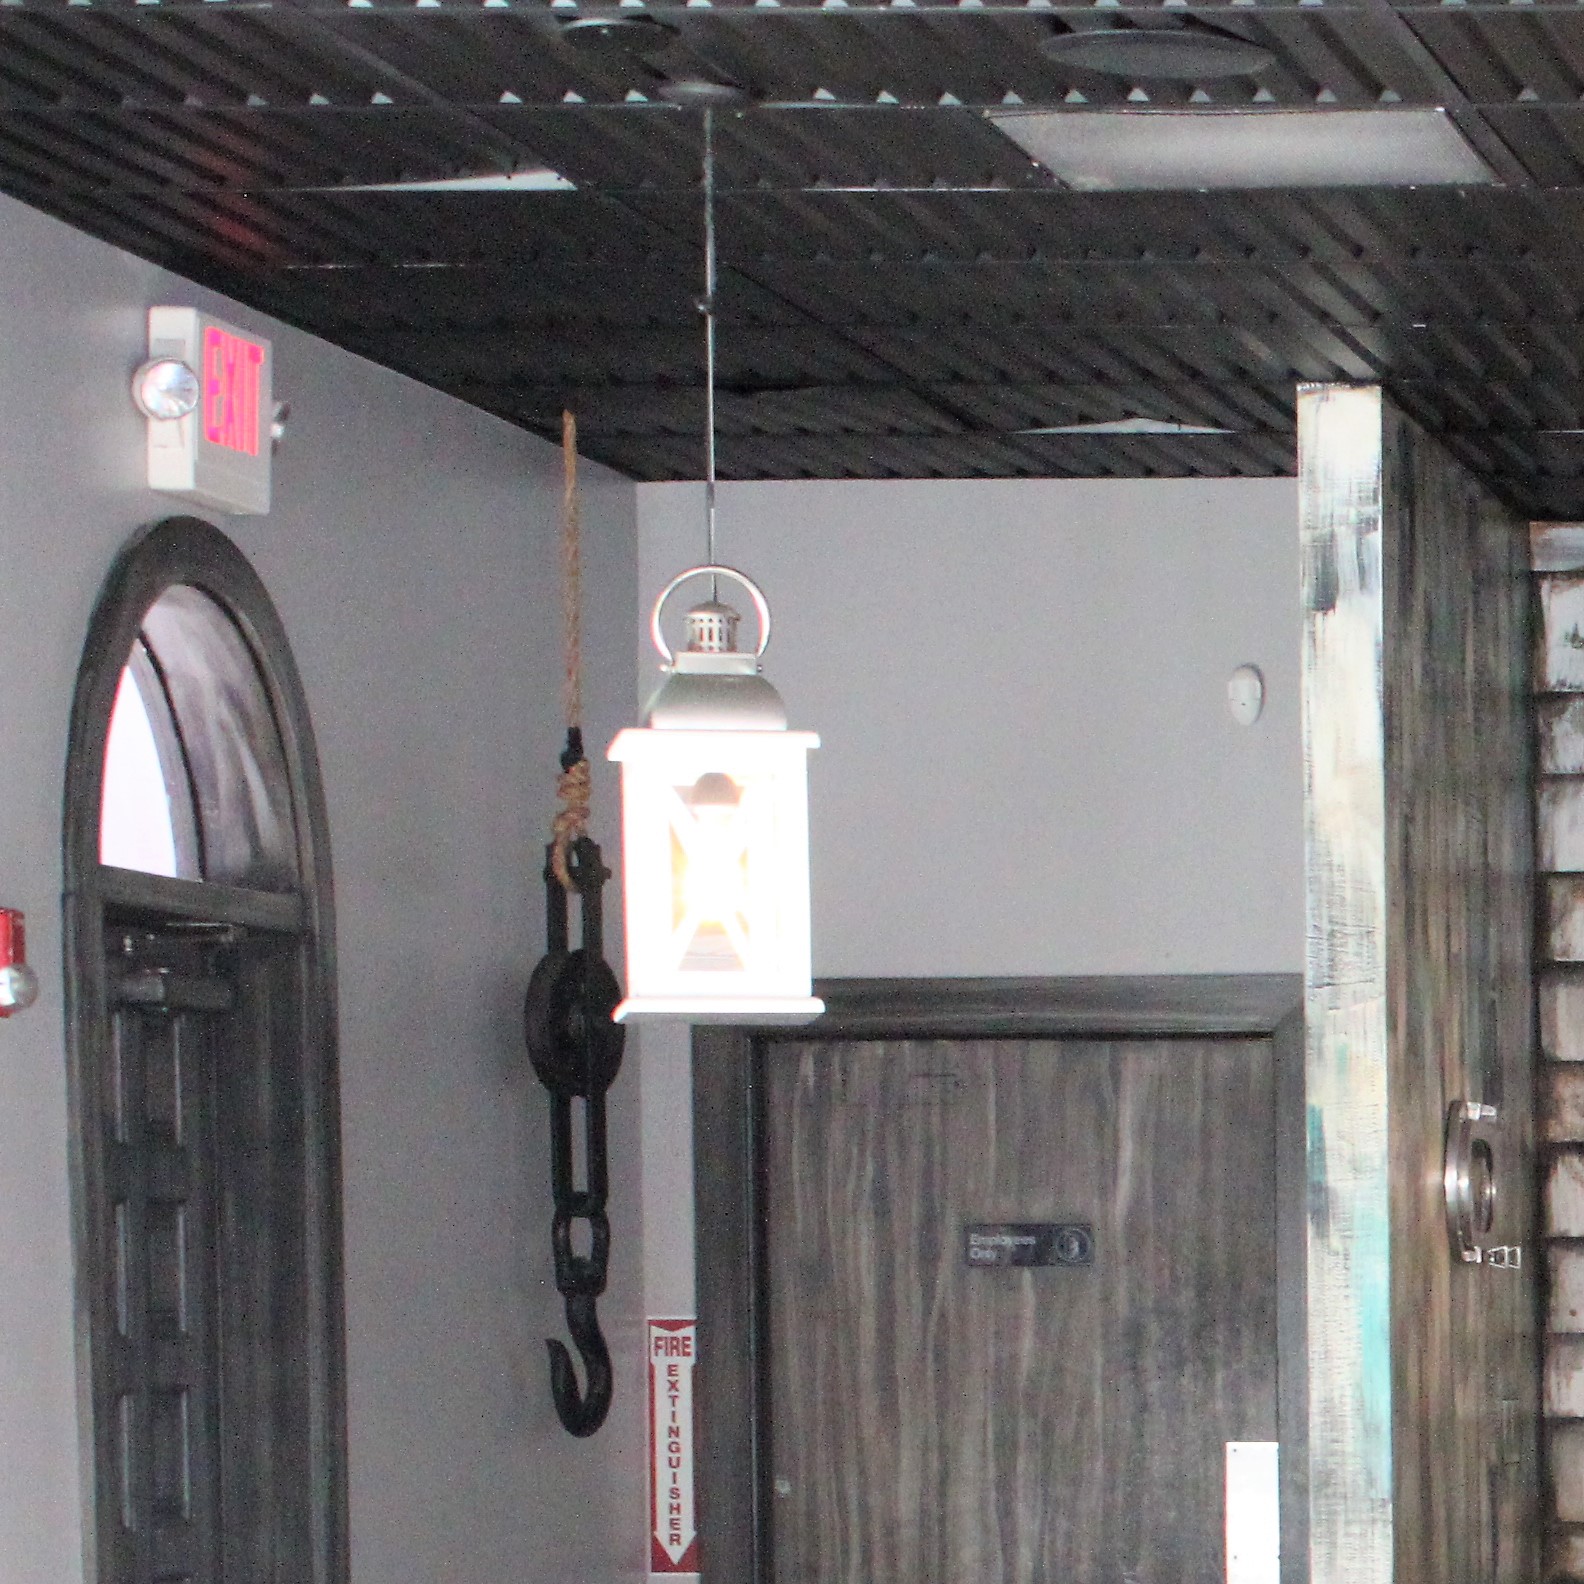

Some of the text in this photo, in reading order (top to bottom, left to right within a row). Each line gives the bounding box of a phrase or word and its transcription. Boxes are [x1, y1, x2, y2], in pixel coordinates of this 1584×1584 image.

[203, 325, 265, 457] EXIT
[654, 1336, 692, 1357] FIRE
[666, 1364, 682, 1546] EXTINGUISHER
